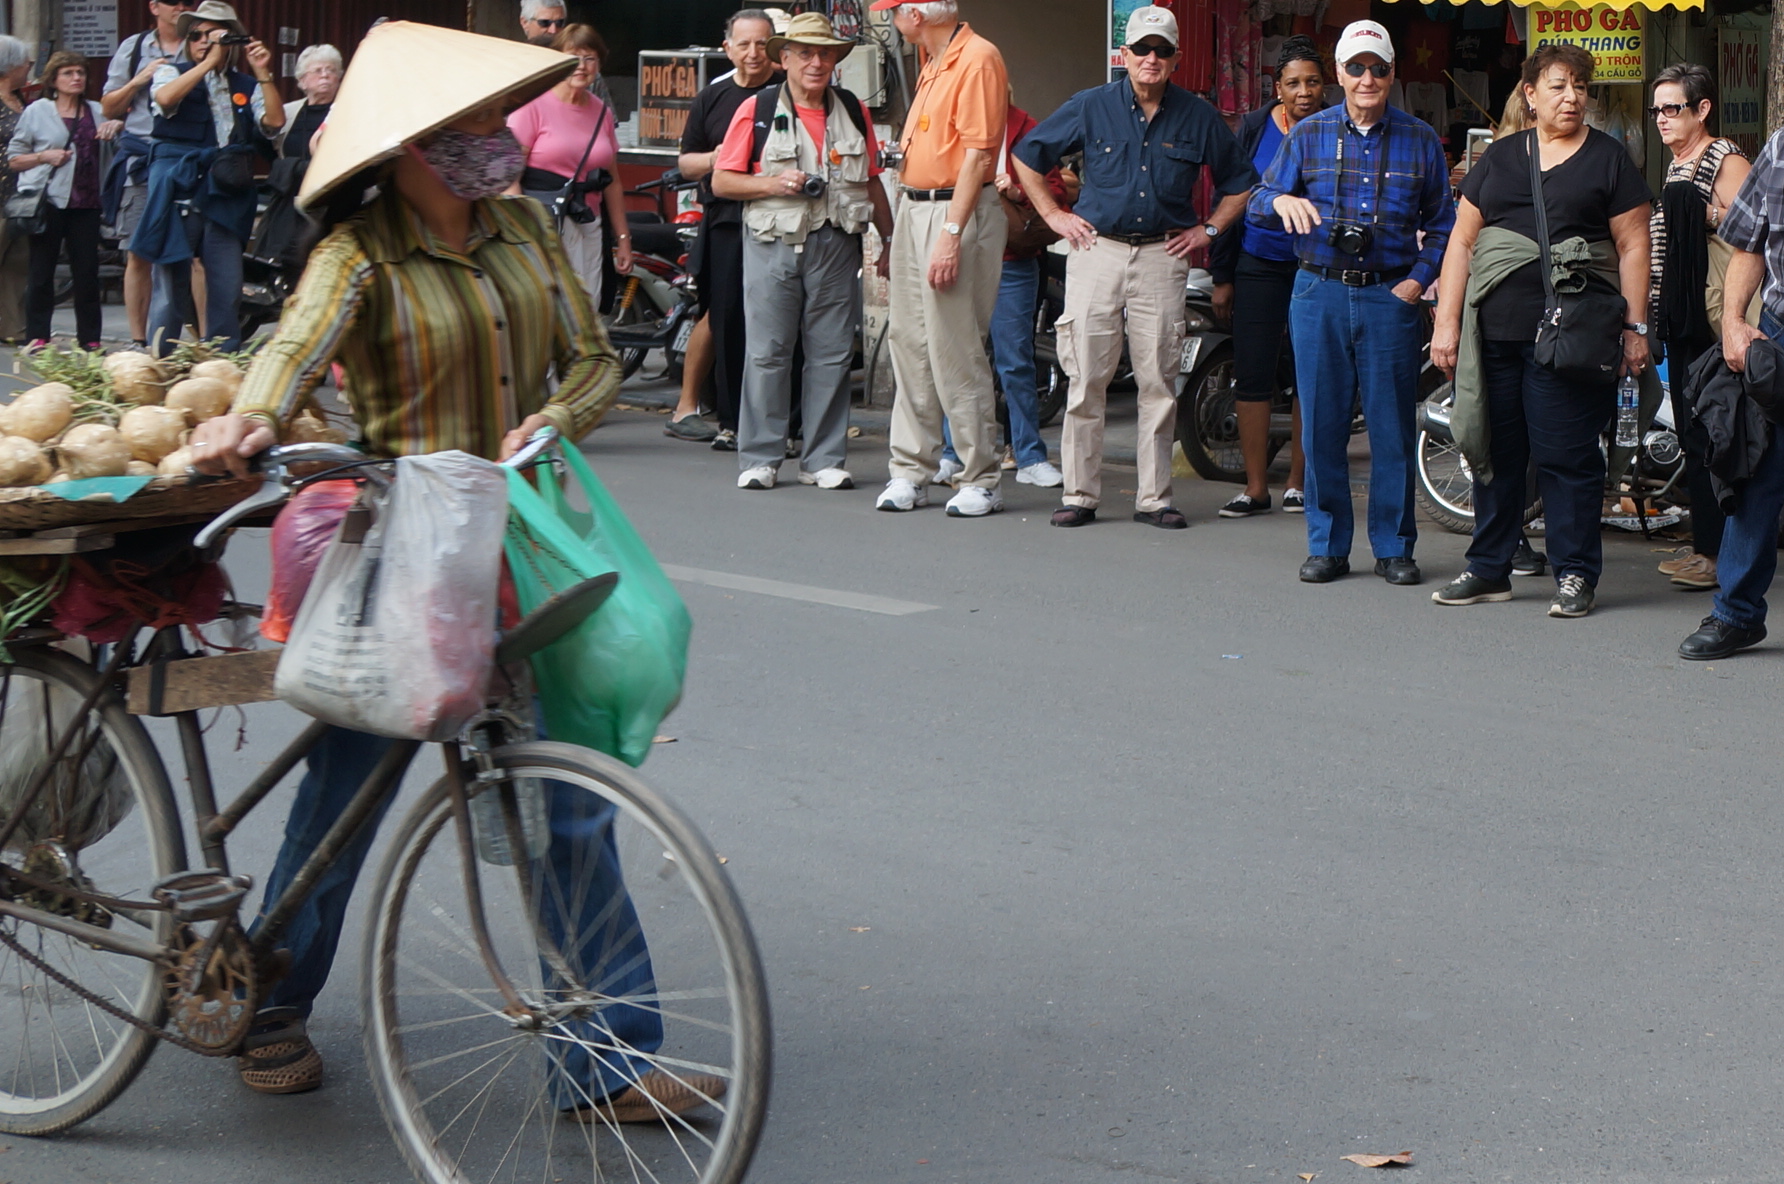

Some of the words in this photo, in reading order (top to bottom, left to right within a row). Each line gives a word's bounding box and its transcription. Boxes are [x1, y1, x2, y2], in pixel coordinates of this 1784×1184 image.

[1580, 35, 1641, 52] THANG
[1606, 52, 1641, 69] TRỘN
[642, 57, 674, 99] PHỞ
[676, 58, 697, 98] GÀ
[1594, 70, 1604, 78] 34
